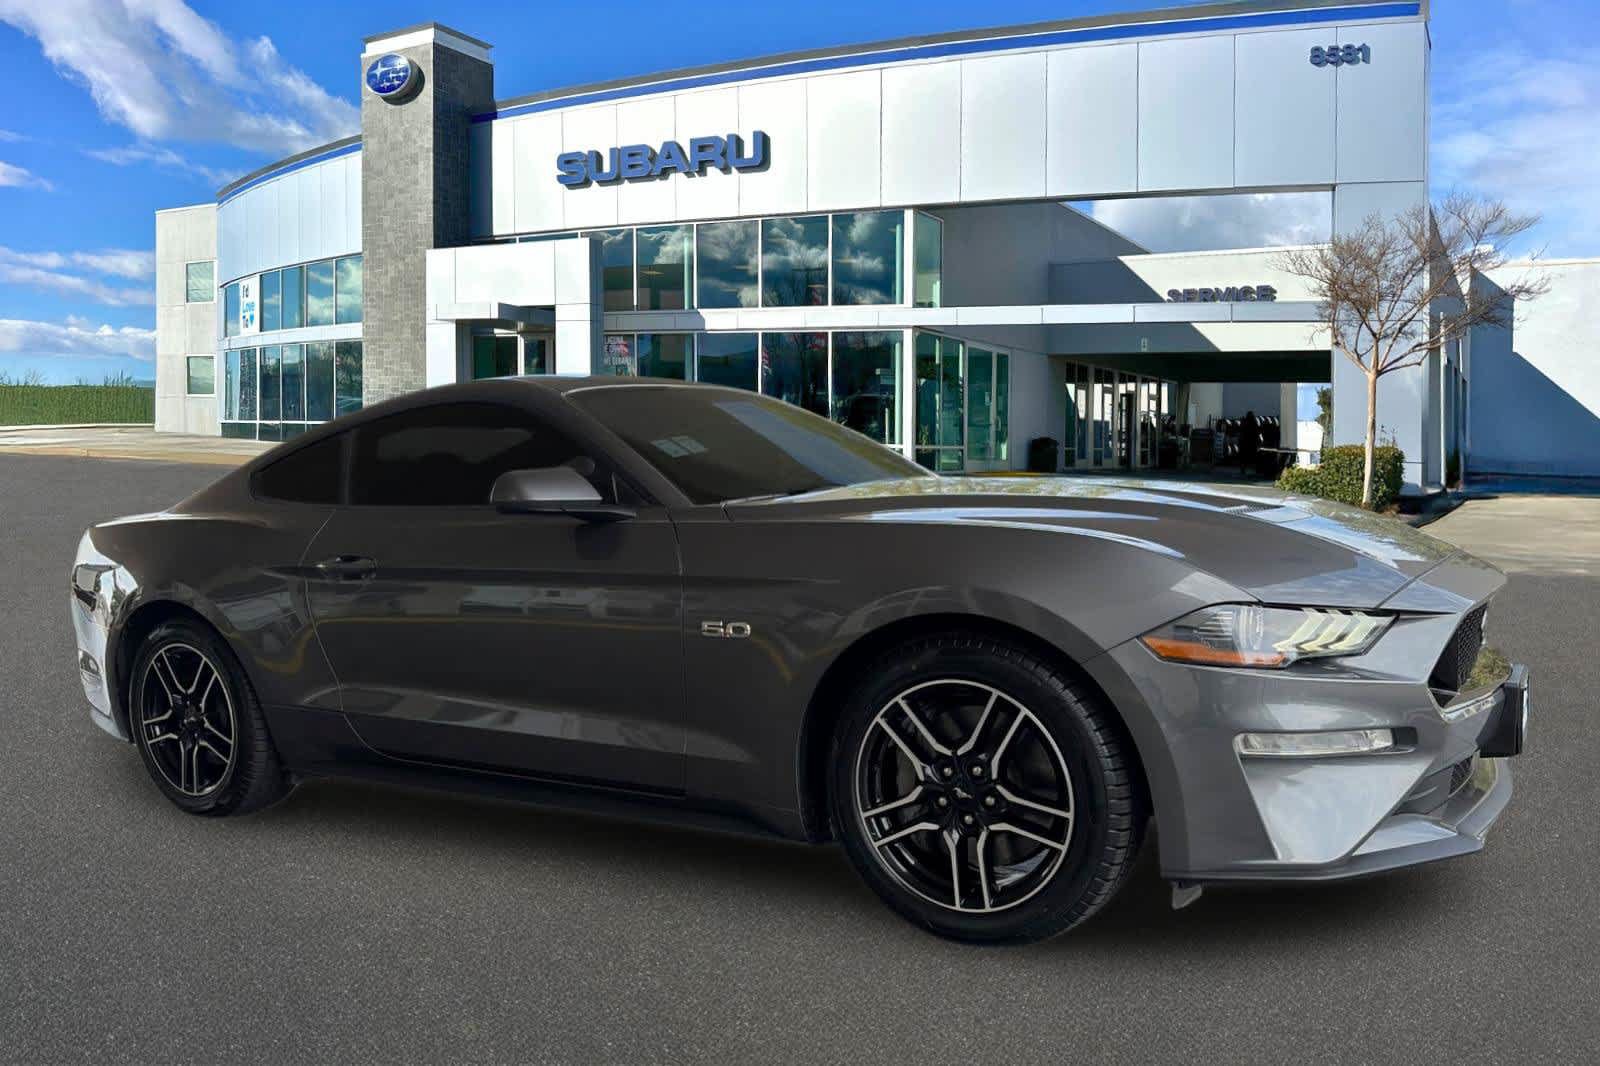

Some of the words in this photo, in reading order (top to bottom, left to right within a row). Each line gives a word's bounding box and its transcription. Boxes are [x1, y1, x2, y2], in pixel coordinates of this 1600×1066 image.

[556, 129, 769, 188] SUBARU
[1166, 284, 1278, 303] SERVICE
[701, 620, 752, 638] 5.0
